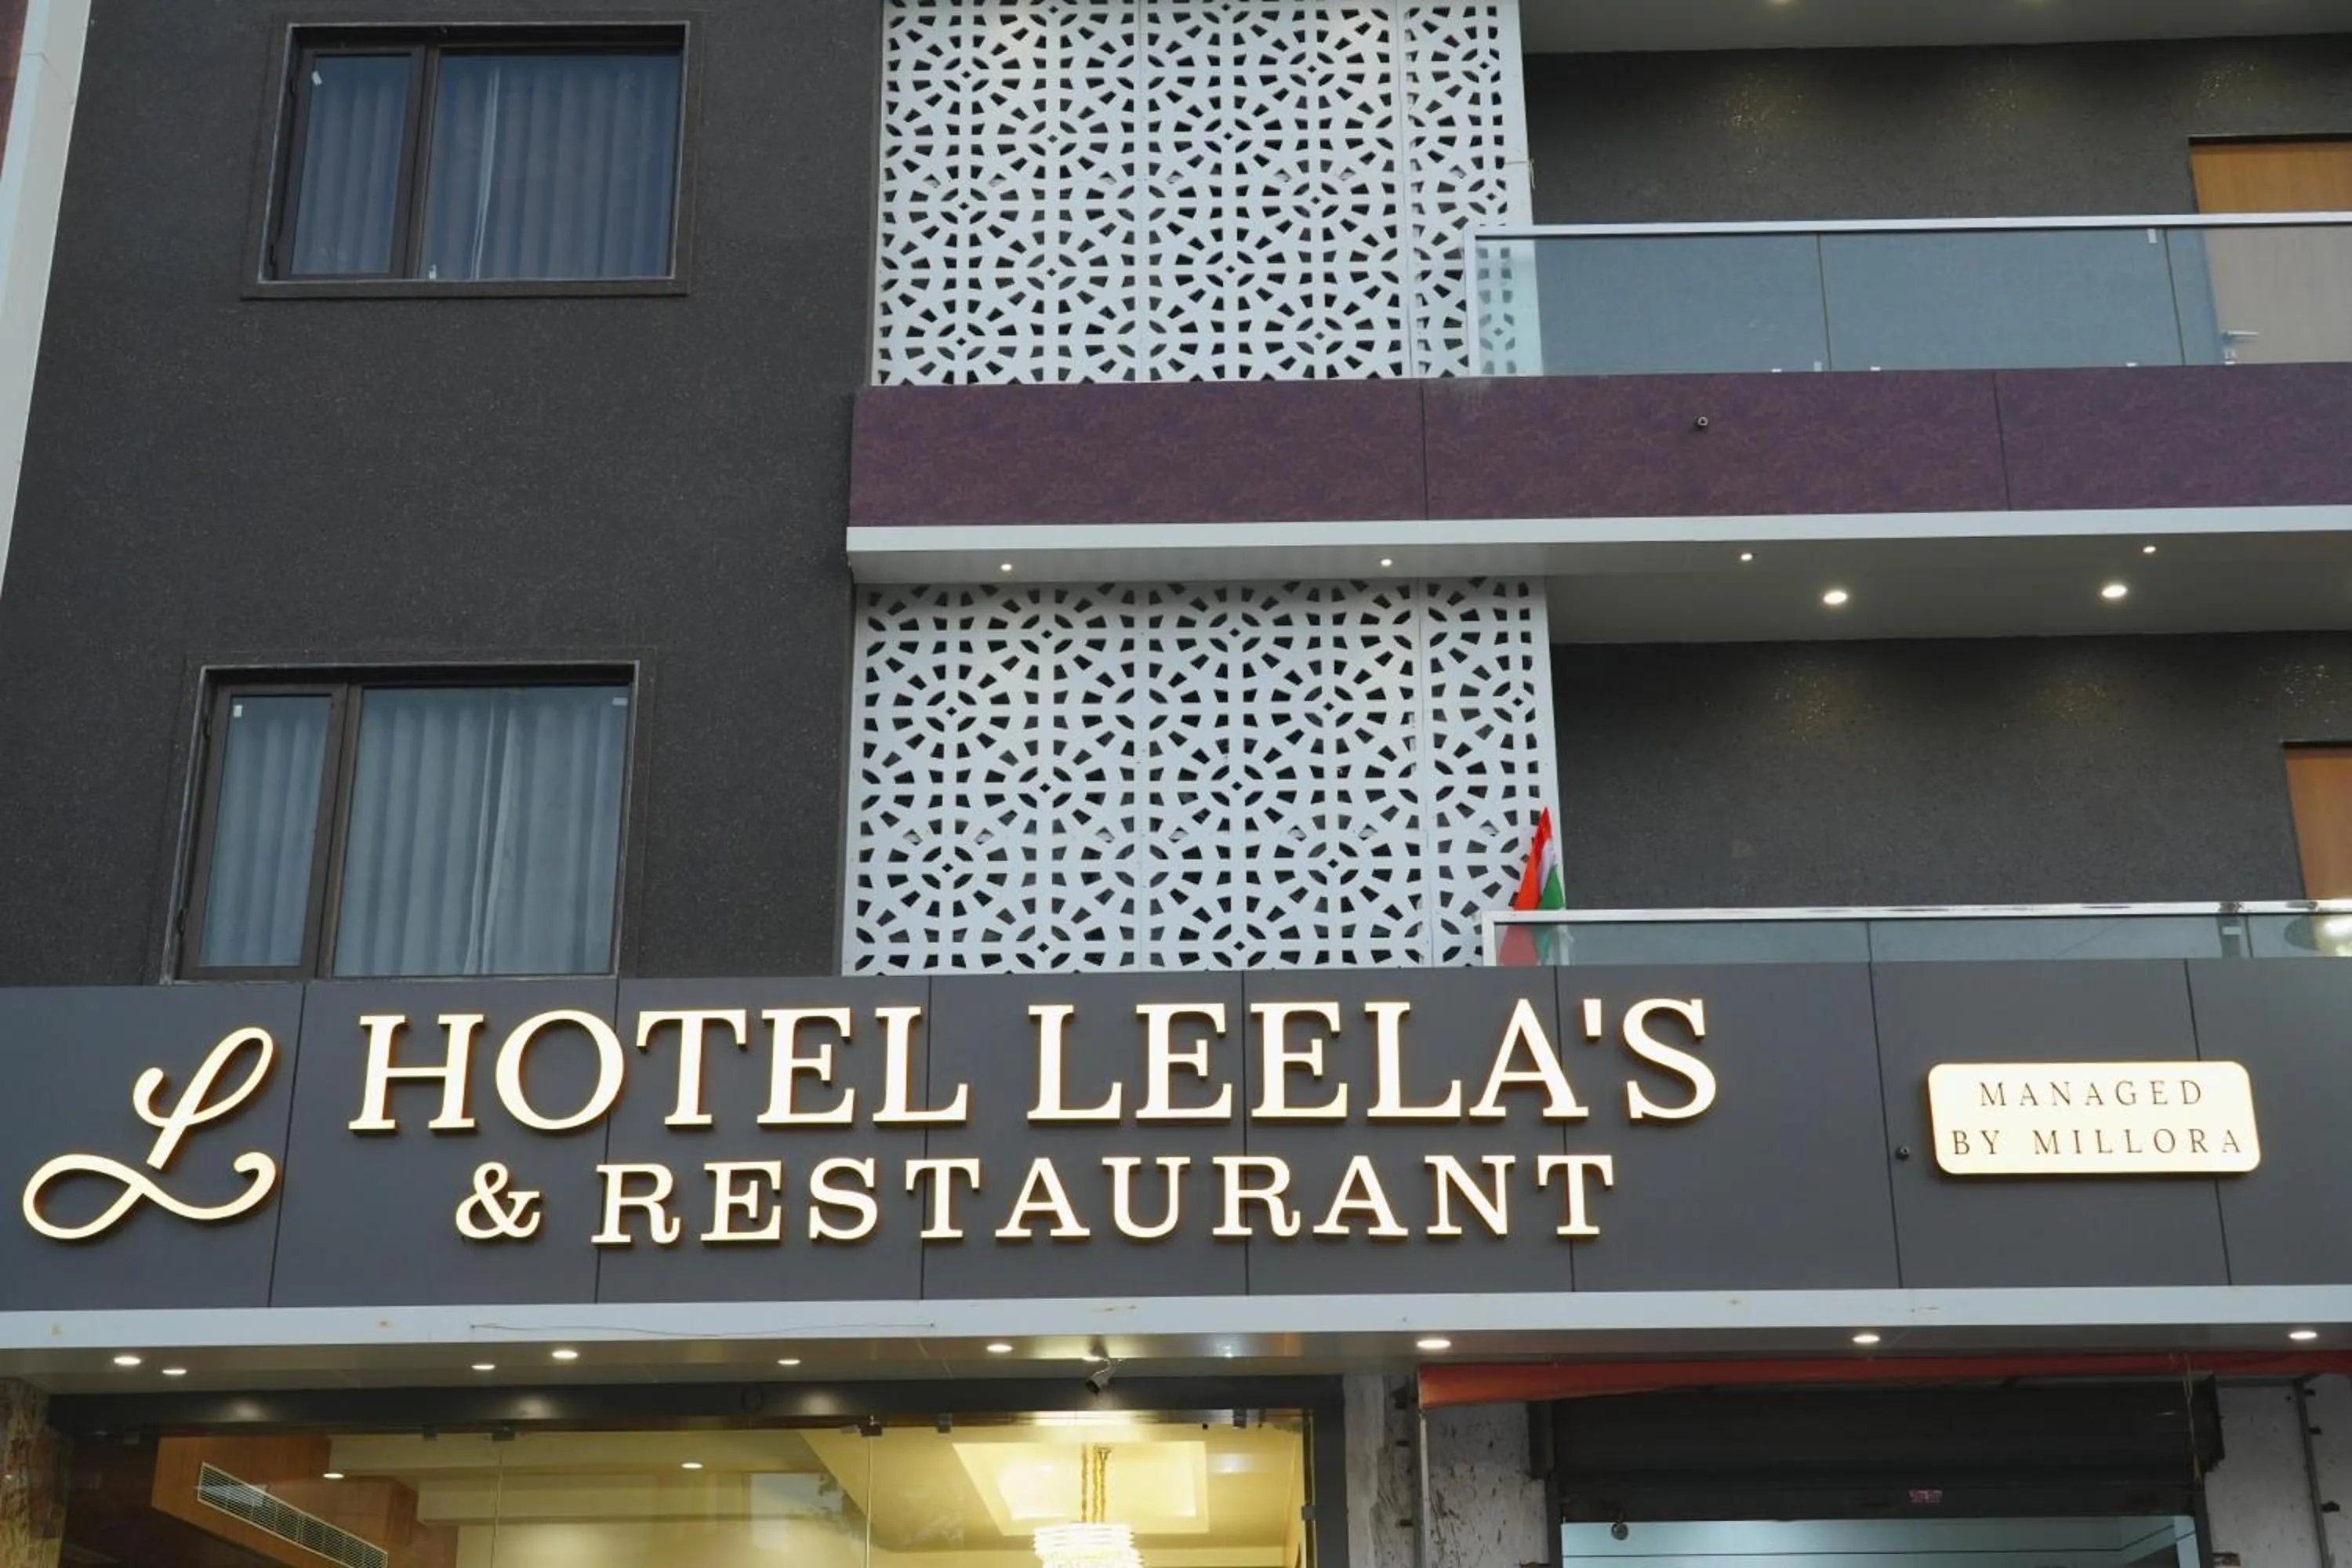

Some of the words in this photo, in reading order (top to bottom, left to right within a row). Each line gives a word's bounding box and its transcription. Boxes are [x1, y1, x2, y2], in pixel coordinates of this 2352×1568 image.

[349, 1007, 968, 1129] HOTEL
[1027, 999, 1716, 1120] LEELA'S
[1980, 1080, 2201, 1106] MANAGED
[1952, 1129, 2000, 1155] BY
[2033, 1128, 2241, 1155] MILLORA
[456, 1162, 540, 1239] &
[592, 1155, 1613, 1243] RESTAURANT
